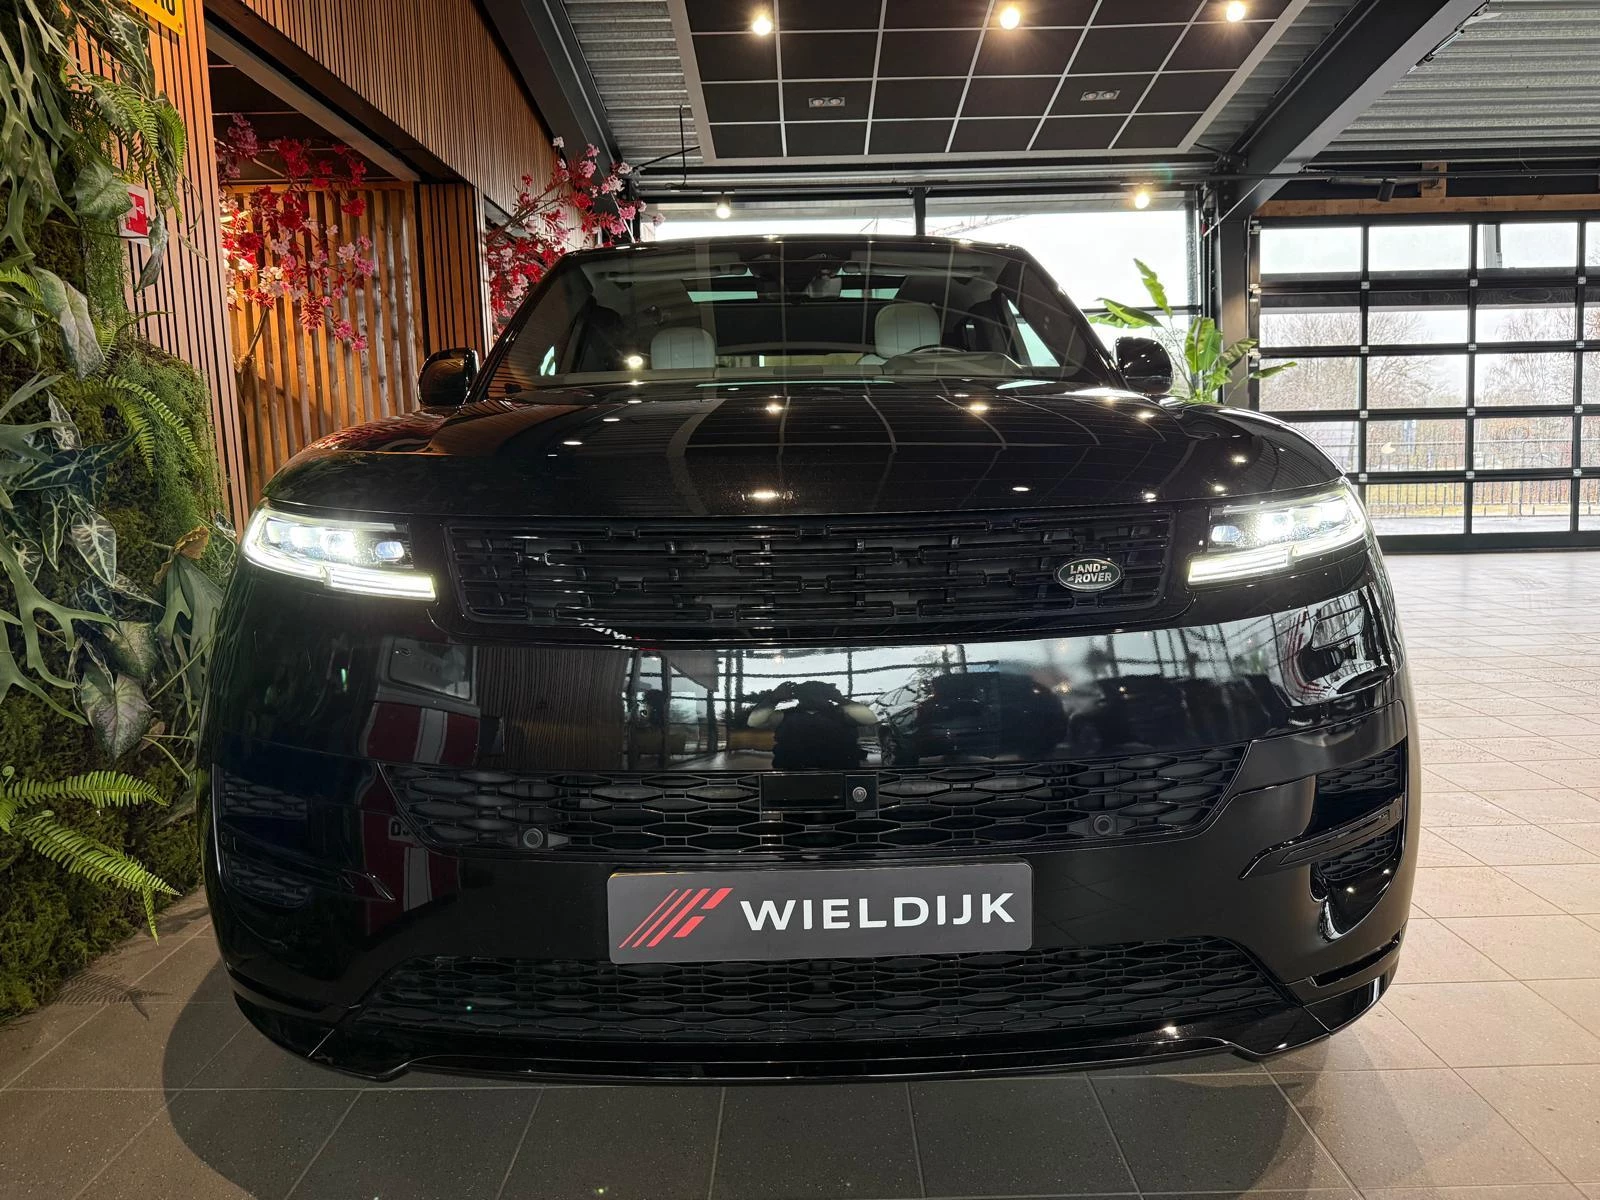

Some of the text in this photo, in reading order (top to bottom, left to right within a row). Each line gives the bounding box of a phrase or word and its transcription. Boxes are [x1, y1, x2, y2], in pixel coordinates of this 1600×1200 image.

[1070, 563, 1101, 574] LAND
[1074, 572, 1112, 584] ROVER
[739, 892, 1016, 931] WIELDIJK
